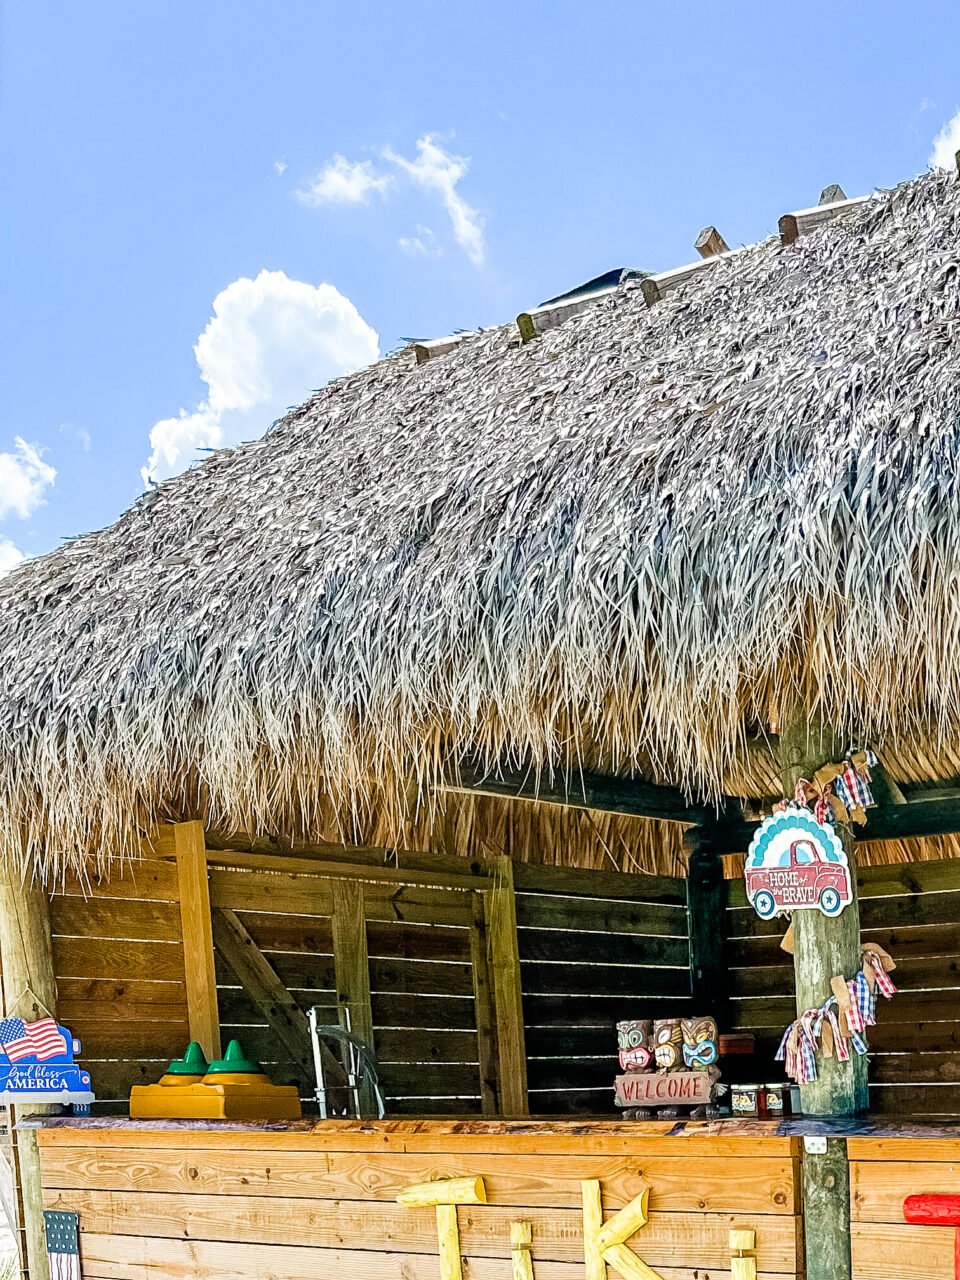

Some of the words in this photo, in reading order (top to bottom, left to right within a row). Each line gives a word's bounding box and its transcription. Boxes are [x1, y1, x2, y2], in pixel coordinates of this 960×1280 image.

[768, 871, 799, 887] HOME
[782, 886, 815, 903] BRAVE
[5, 1078, 69, 1089] AMERICA
[622, 1076, 703, 1101] WELCOME
